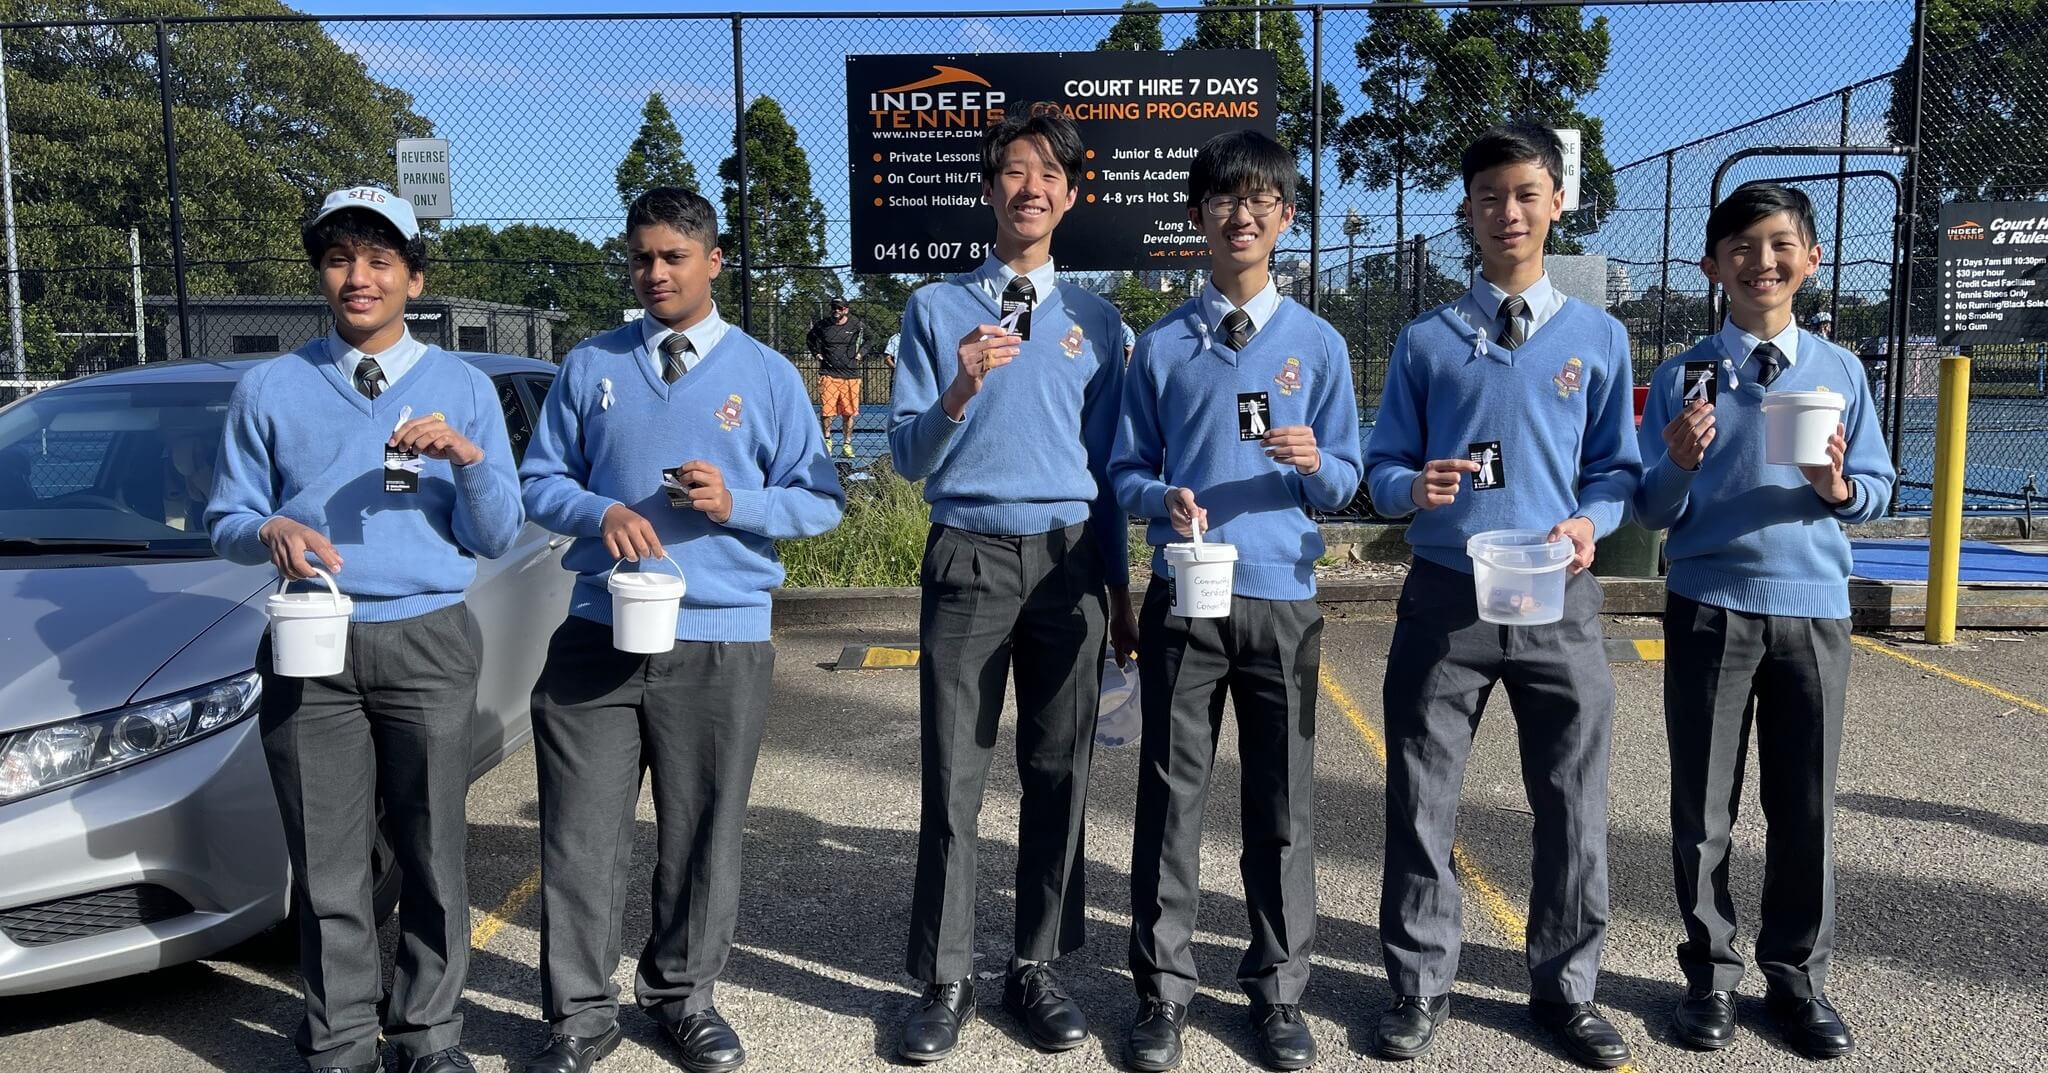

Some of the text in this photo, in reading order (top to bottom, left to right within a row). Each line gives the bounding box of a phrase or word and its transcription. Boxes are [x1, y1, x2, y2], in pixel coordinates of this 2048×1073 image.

[1064, 77, 1259, 97] COURT HIRE 7 DAYS
[870, 91, 1006, 111] INDEEP
[1146, 101, 1259, 119] PROGRAMS
[868, 109, 1006, 128] TENNIS
[401, 151, 445, 163] REVERSE
[889, 151, 981, 163] Private Lessons
[1112, 147, 1199, 160] Junior & Adult
[403, 172, 445, 185] PARKING
[887, 172, 981, 184] On Court Hit/Fi
[1102, 169, 1190, 181] Tennis Academ
[414, 194, 437, 206] ONLY
[888, 195, 928, 207] School
[931, 195, 977, 208] Holiday
[1102, 192, 1122, 204] 4-8
[1126, 194, 1144, 206] yrs
[1147, 192, 1169, 203] Hot
[1990, 217, 2036, 231] Court
[1992, 231, 2048, 245] & Rules
[873, 242, 997, 260] 0416 007 81
[1955, 256, 2047, 268] 7 Days 7am till 10:30pm
[1956, 270, 1971, 278] $30
[1972, 270, 1985, 279] per
[1955, 278, 2036, 288] Credit Card Facilities
[1956, 289, 2028, 299] Tennis Shoes Only
[1955, 302, 1968, 310] No
[1955, 311, 2004, 321] No Smoking
[1955, 322, 1988, 331] No Gum
